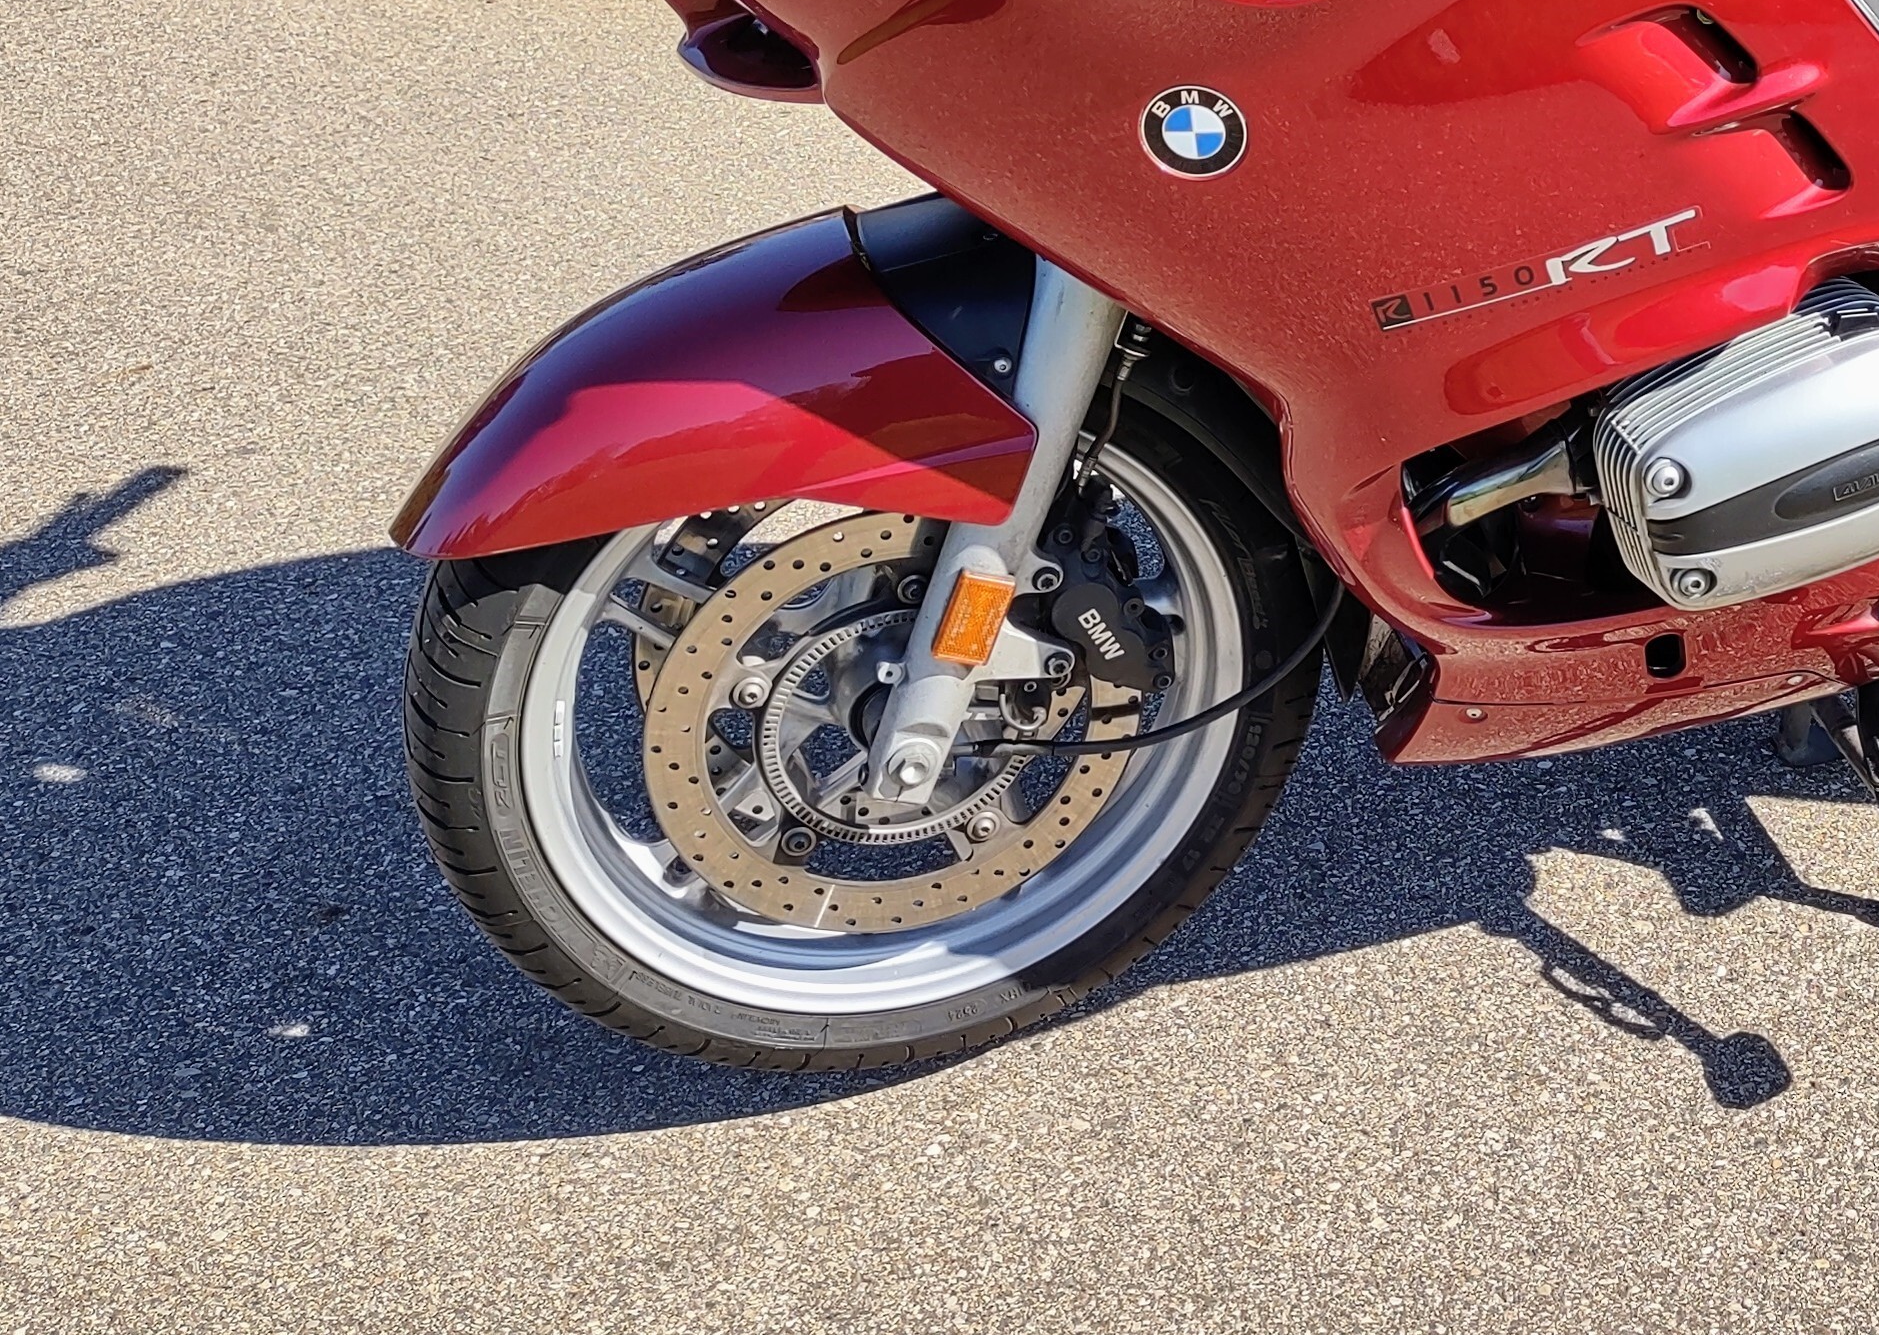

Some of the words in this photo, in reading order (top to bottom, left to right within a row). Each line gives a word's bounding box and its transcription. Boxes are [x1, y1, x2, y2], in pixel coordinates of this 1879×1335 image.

[1151, 90, 1233, 118] BMW
[1423, 265, 1535, 311] 1150
[1545, 209, 1696, 286] RT
[1078, 608, 1125, 660] BMW
